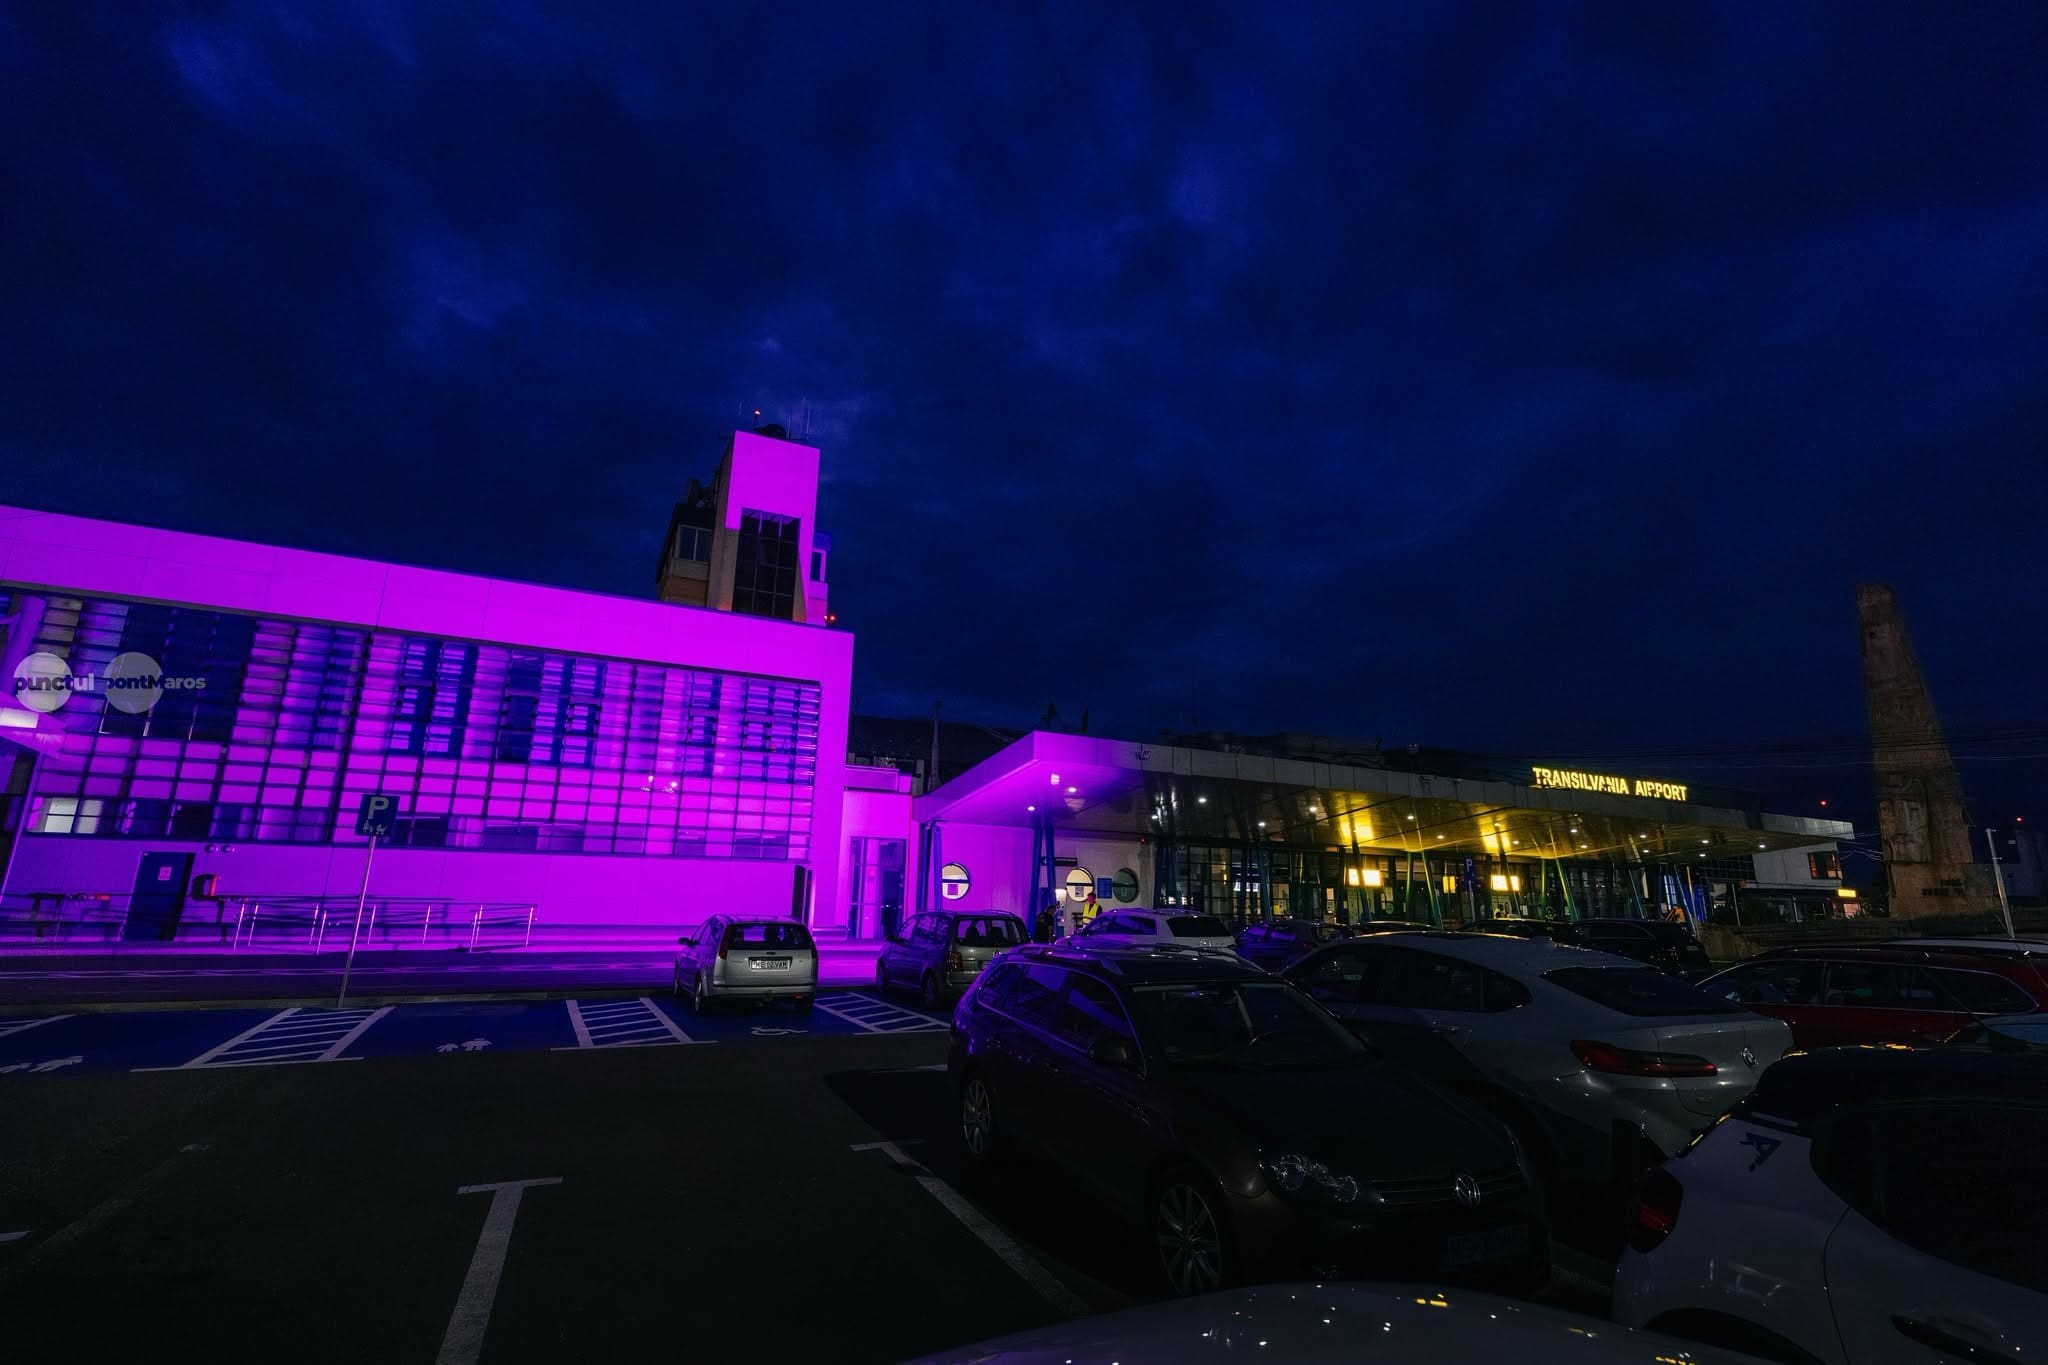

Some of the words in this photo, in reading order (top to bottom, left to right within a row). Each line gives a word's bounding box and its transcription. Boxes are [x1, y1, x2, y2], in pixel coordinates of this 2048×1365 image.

[1532, 766, 1630, 795] TRANSILVANIA
[1635, 780, 1688, 802] AIRPORT
[367, 796, 390, 820] P
